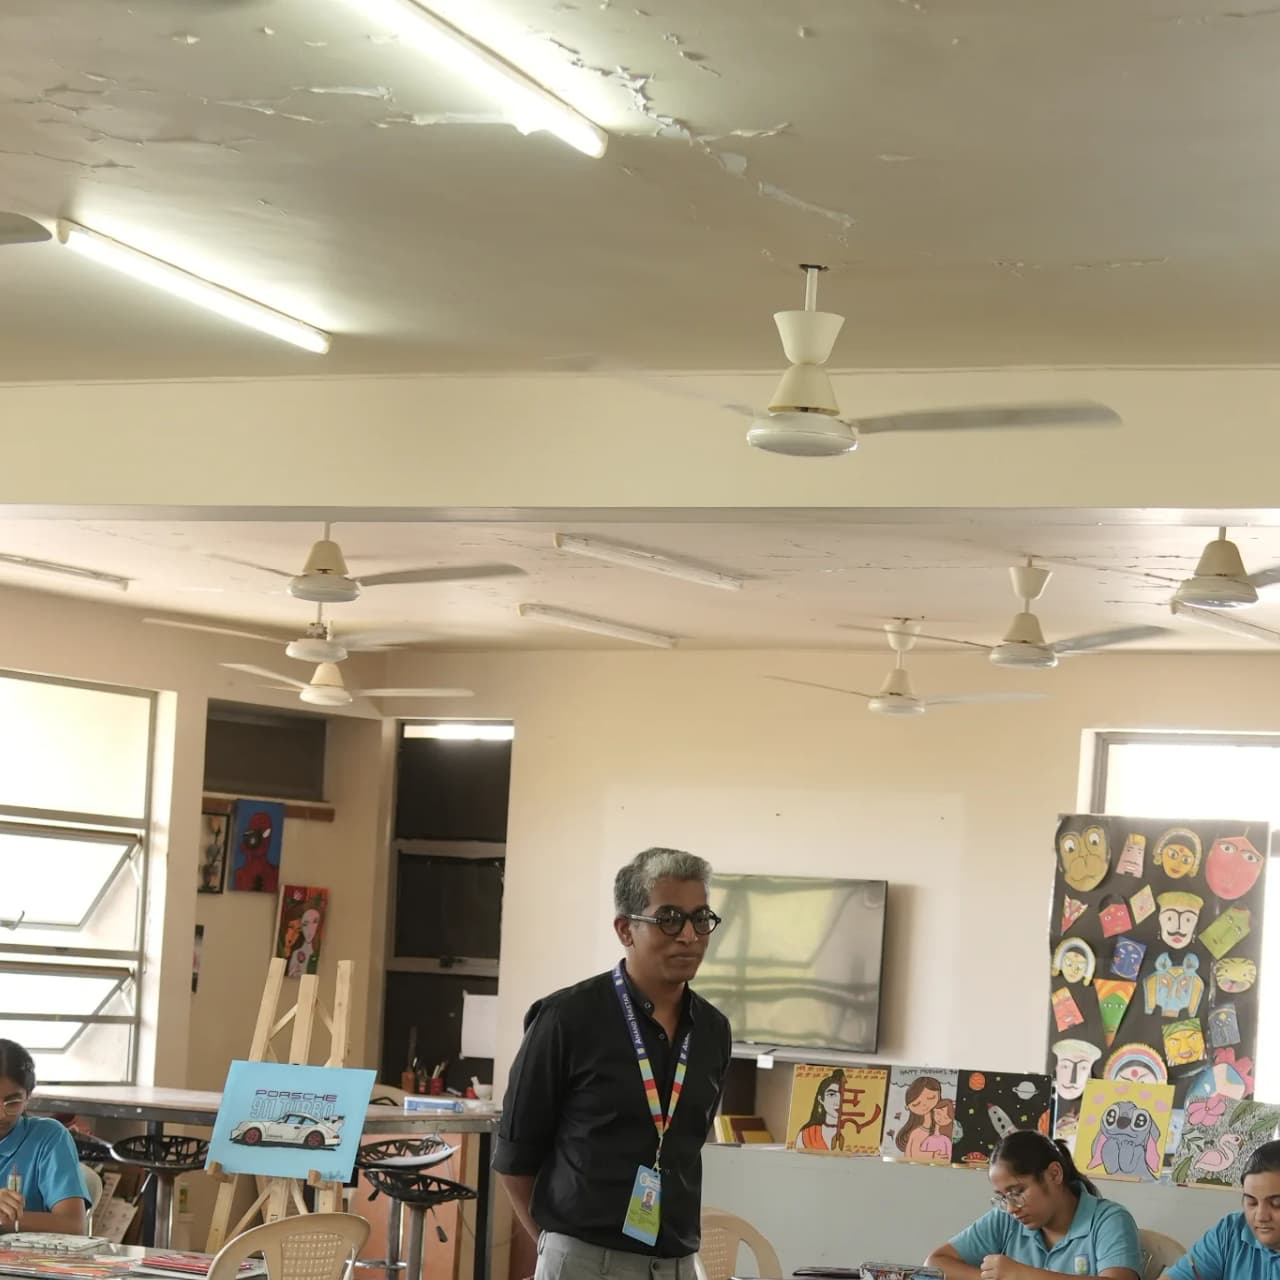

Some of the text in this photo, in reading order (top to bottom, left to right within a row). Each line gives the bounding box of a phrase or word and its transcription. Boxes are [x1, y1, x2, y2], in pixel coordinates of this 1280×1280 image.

[255, 1089, 337, 1102] PORSCHE
[250, 1098, 336, 1121] 911 TURBO
